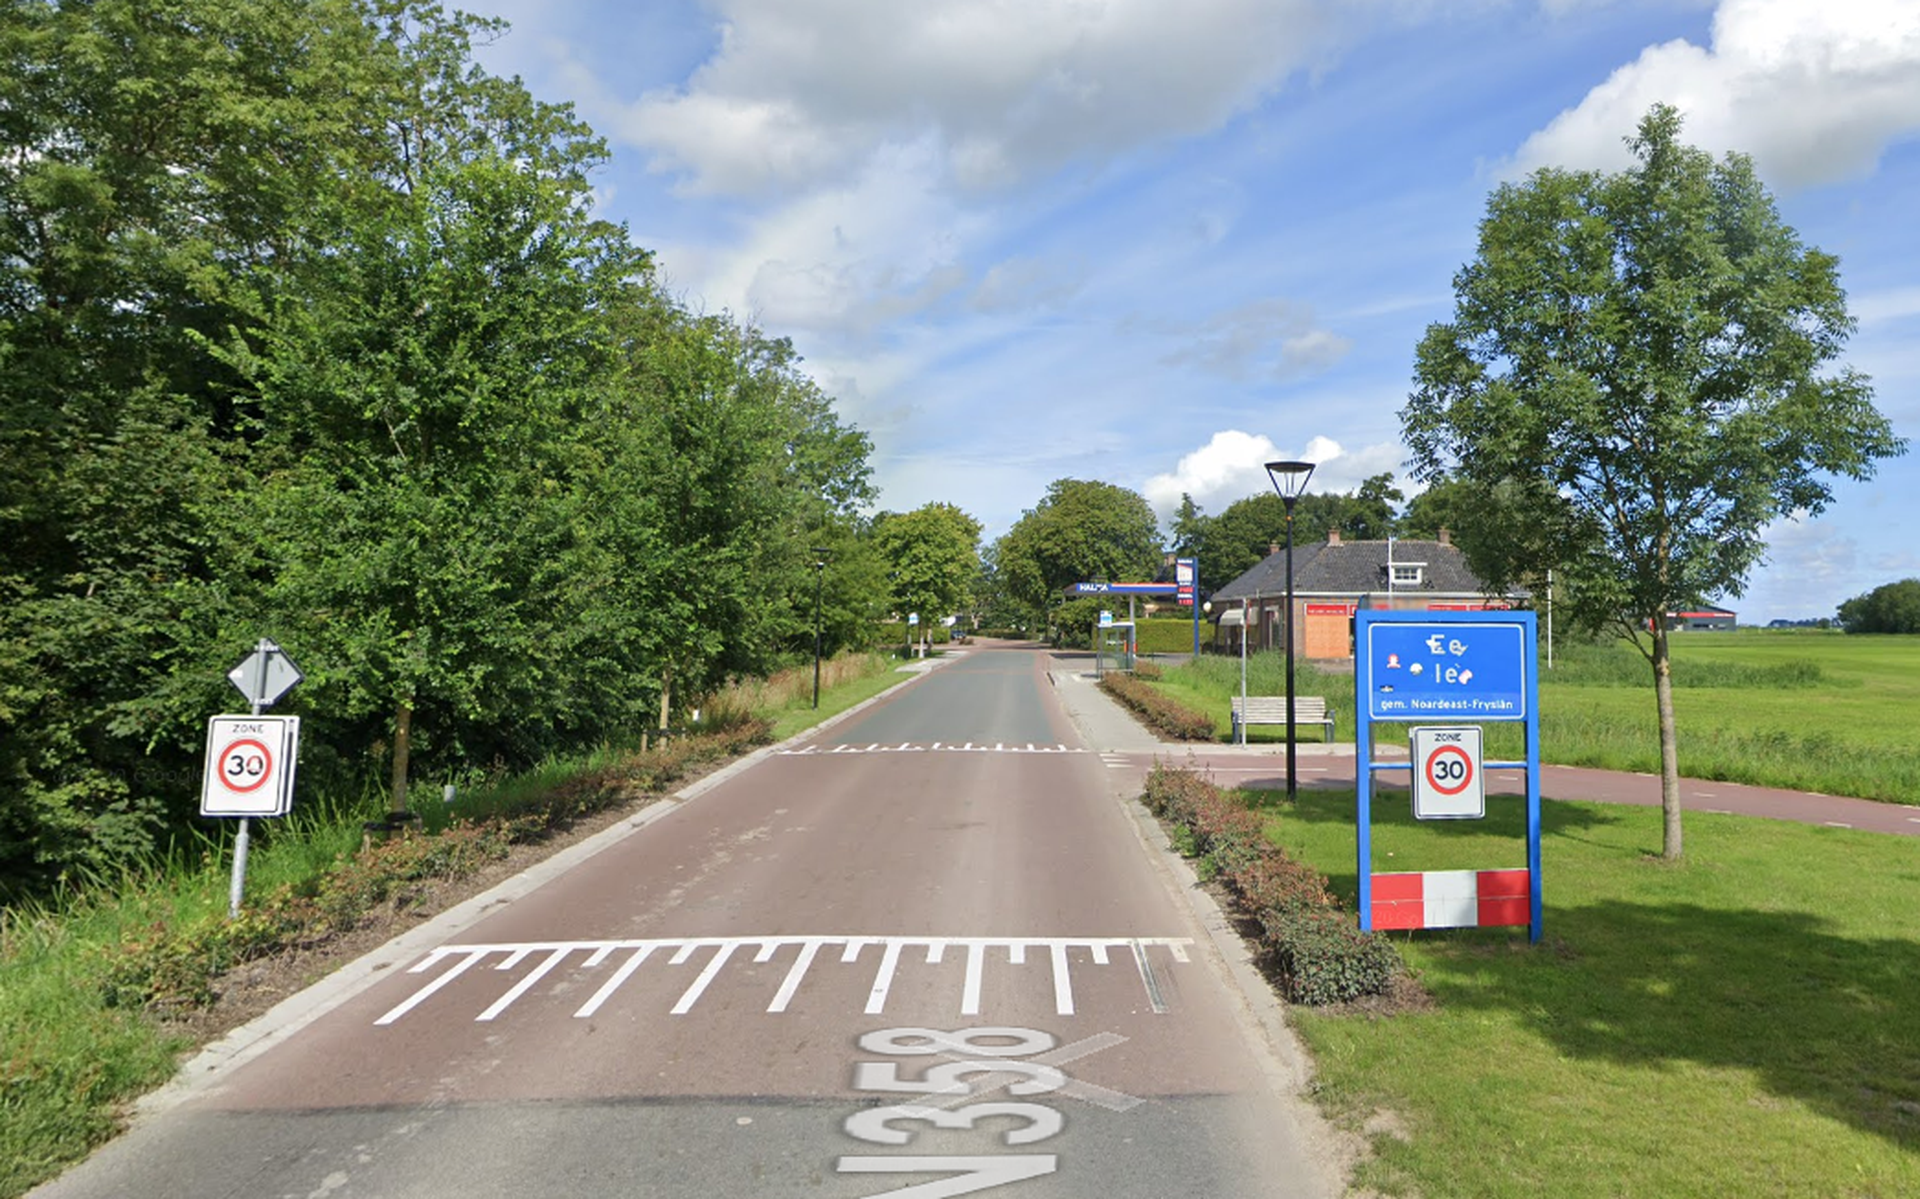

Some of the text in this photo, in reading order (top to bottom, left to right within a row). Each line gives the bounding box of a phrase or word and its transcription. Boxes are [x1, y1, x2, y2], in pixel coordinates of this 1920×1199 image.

[1430, 634, 1462, 655] Ee
[1381, 699, 1513, 711] gem. Noardeast-Fryslân
[232, 723, 265, 734] ZONE
[1434, 733, 1462, 742] ZONE
[227, 755, 264, 776] 30
[1435, 760, 1465, 780] 30
